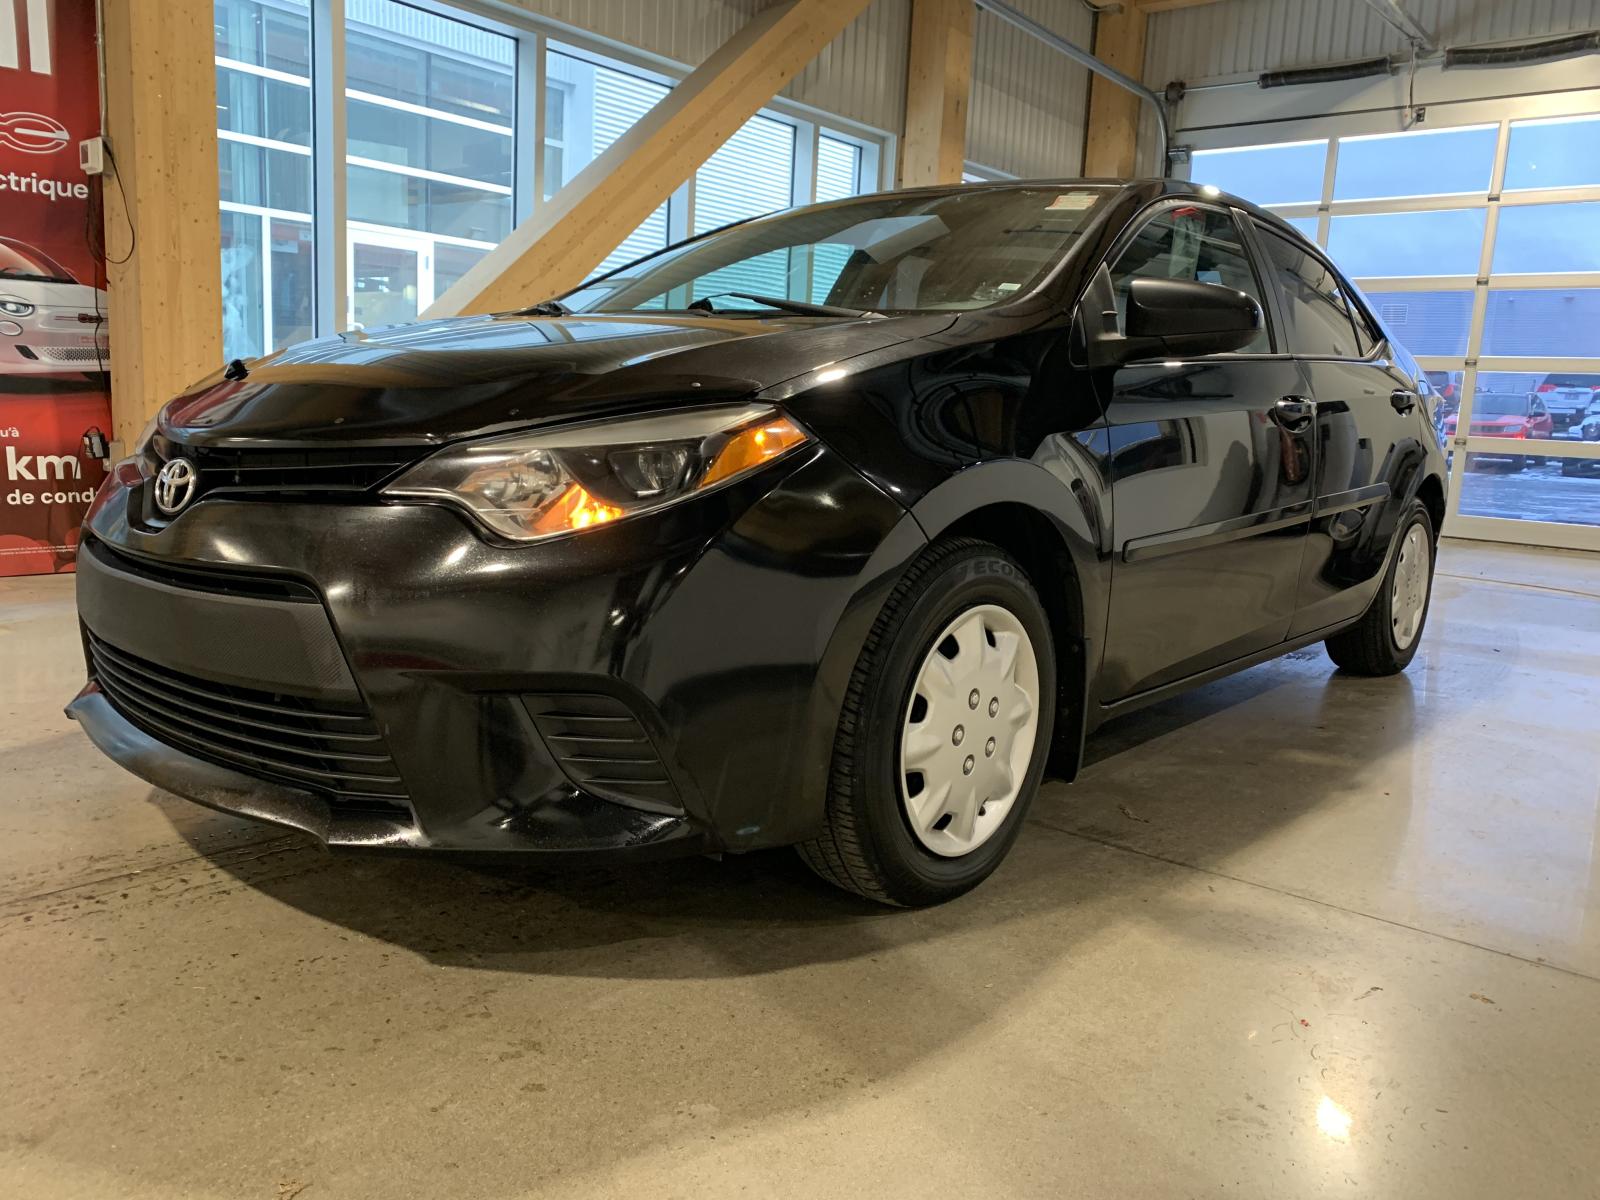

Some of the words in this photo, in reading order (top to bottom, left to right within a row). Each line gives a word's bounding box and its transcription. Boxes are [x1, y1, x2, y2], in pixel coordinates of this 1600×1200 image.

[5, 446, 82, 481] km
[6, 489, 36, 505] de
[40, 487, 99, 504] cond
